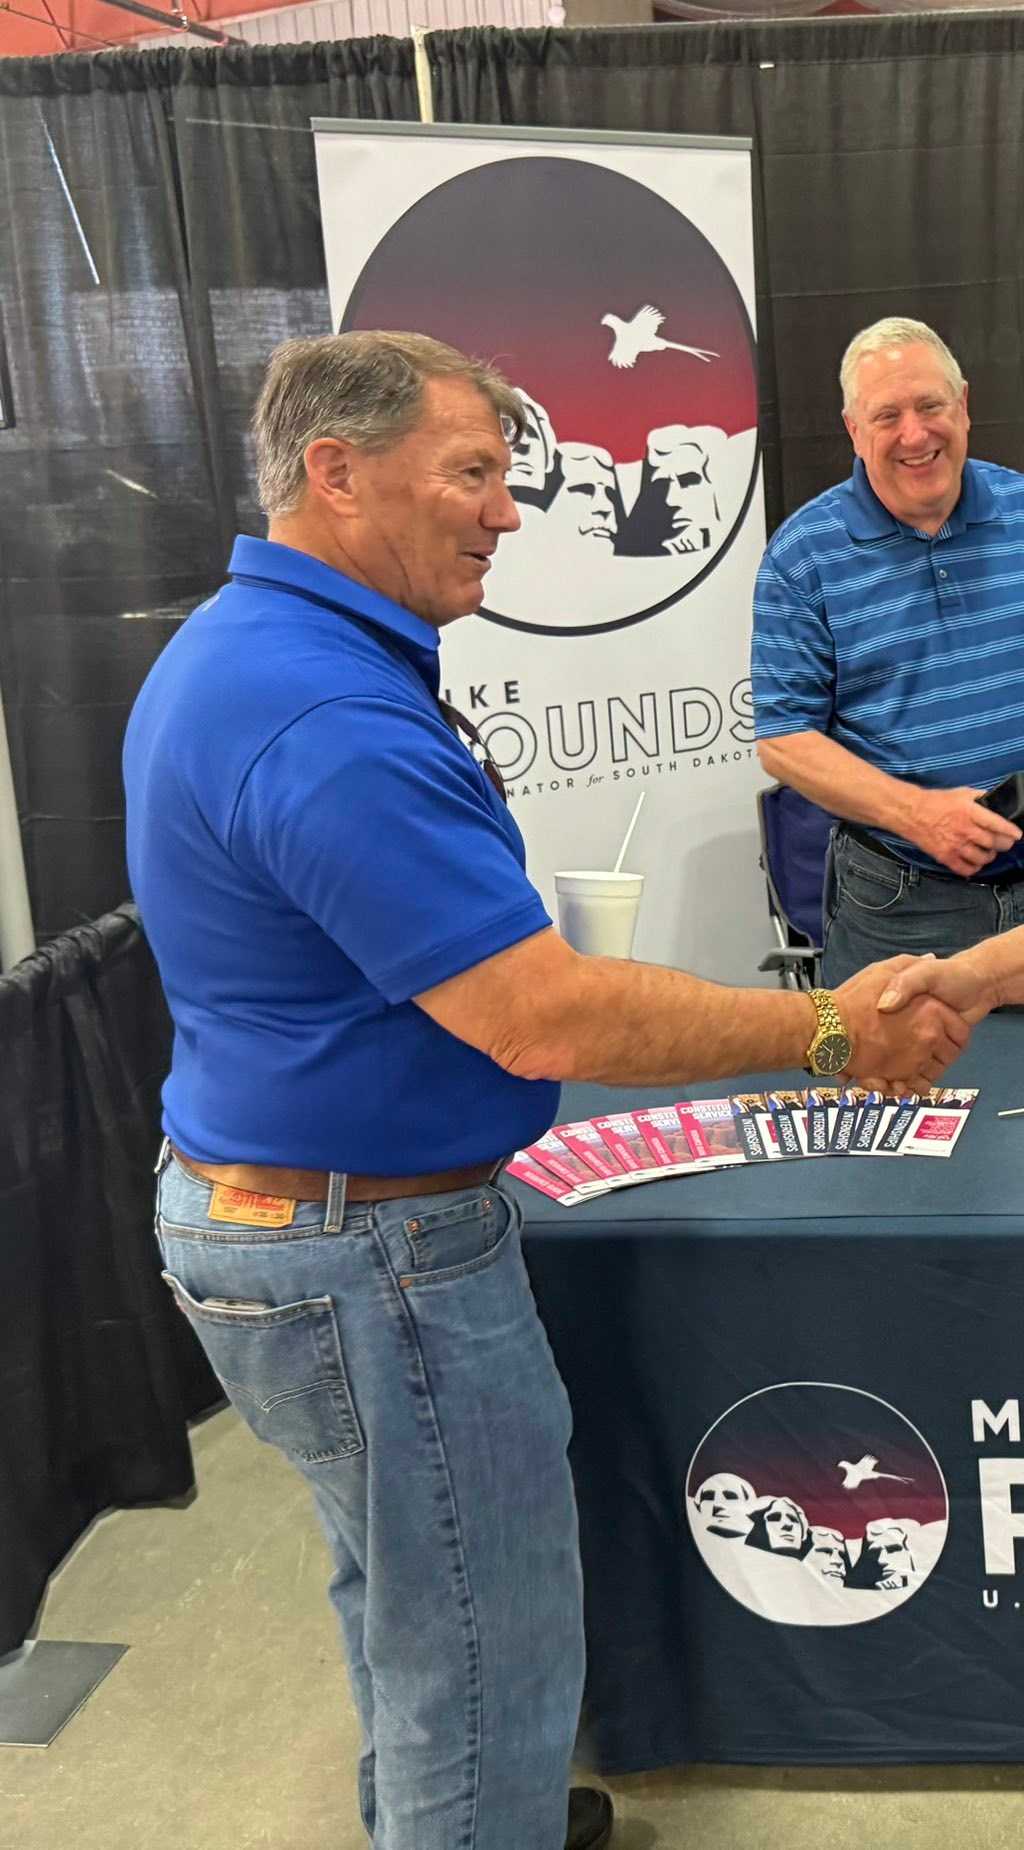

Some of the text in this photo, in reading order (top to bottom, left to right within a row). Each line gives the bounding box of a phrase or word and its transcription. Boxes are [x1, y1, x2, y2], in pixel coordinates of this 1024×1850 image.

[445, 680, 520, 709] IKE
[477, 678, 758, 782] OUNDS
[507, 749, 760, 798] NATOR for SOUTH DAKOT
[741, 1118, 763, 1156] INTERNSHIPS
[778, 1114, 798, 1152] INTERNSHIPS
[812, 1111, 826, 1150] INTERNSHIPS
[835, 1111, 855, 1150] INTERNSHIPS
[856, 1109, 880, 1148] INTERNSHIPS
[883, 1109, 914, 1148] INTERNSHIPS
